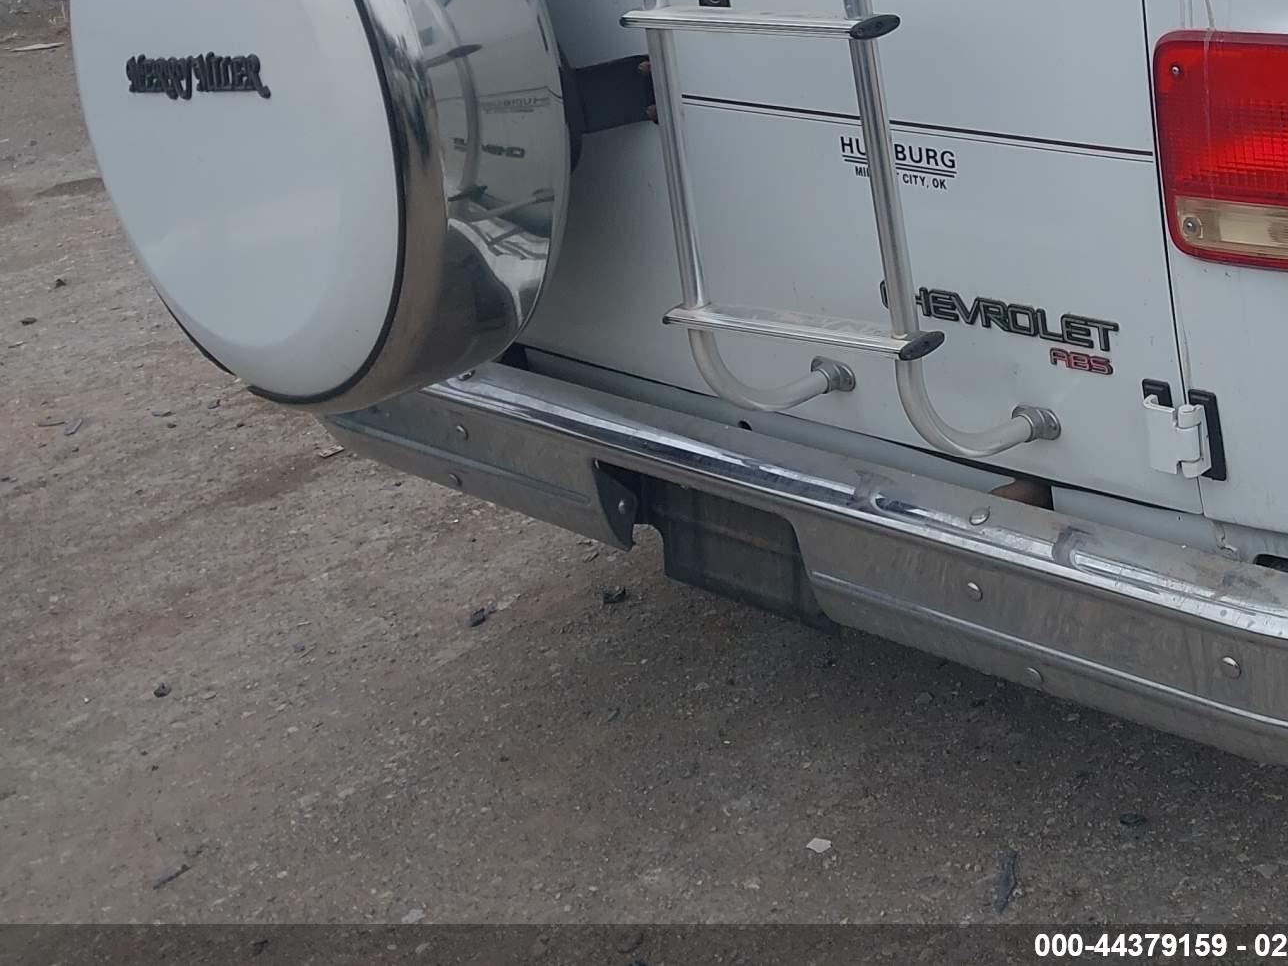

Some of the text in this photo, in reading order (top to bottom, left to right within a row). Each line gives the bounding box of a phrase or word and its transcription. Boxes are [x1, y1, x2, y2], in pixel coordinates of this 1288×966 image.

[840, 135, 956, 168] HUBURG
[932, 177, 947, 190] OK
[1049, 347, 1114, 376] ABS
